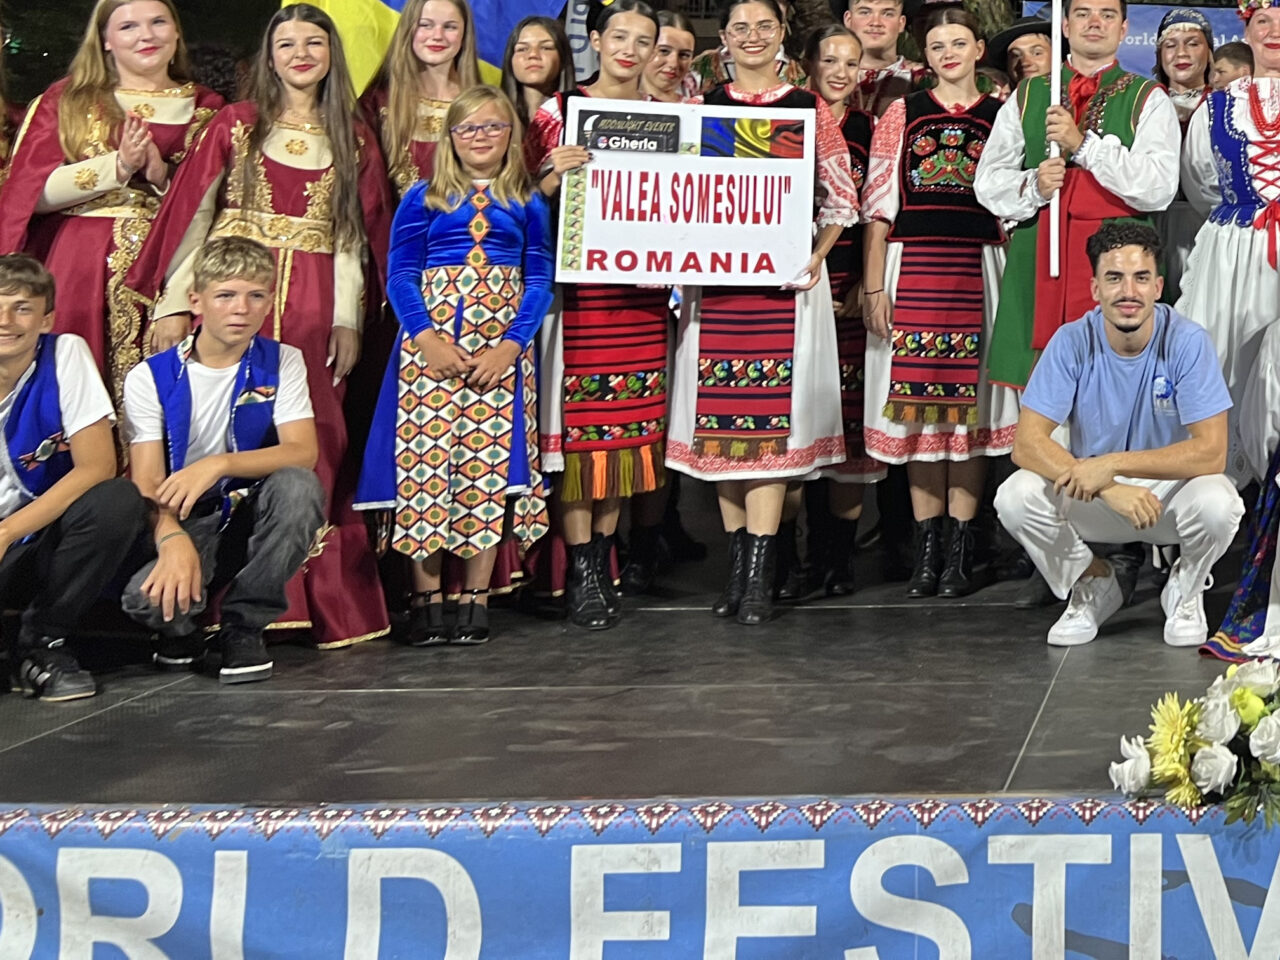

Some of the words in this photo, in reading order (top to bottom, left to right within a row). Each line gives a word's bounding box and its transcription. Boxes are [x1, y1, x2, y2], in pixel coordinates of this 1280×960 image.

[591, 169, 661, 222] "VALEA
[669, 172, 791, 225] SOMESULUI"
[586, 249, 776, 274] ROMANIA
